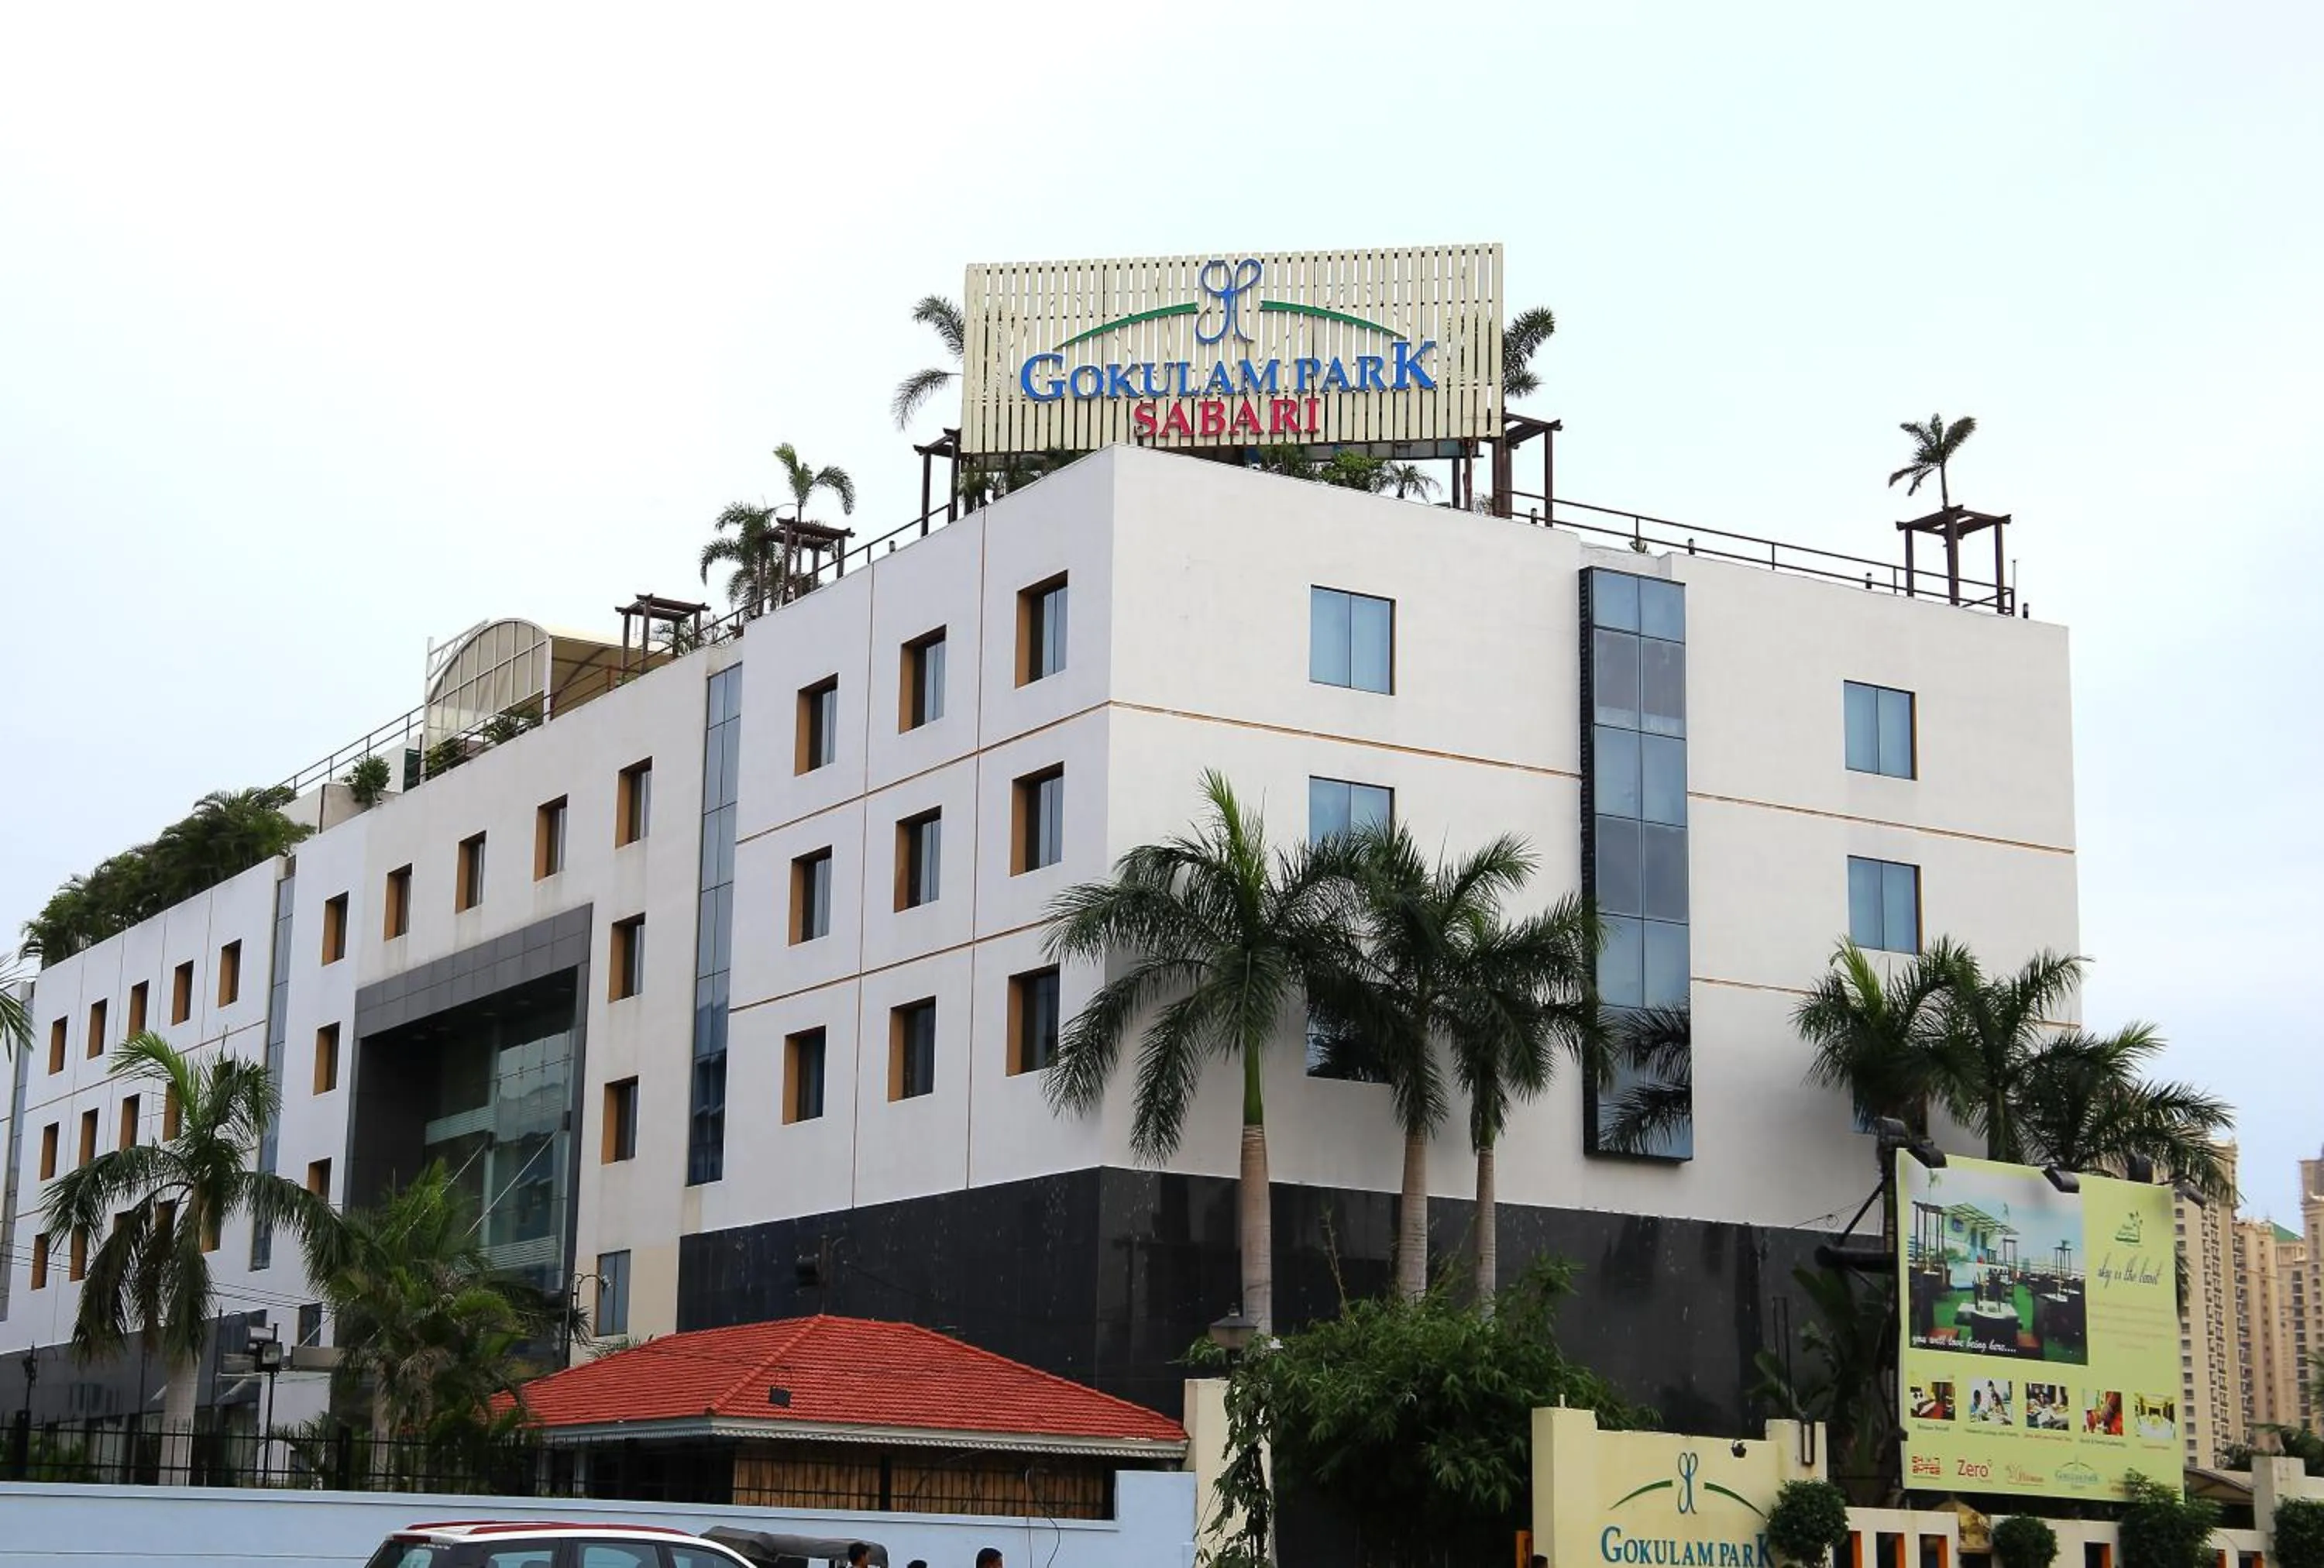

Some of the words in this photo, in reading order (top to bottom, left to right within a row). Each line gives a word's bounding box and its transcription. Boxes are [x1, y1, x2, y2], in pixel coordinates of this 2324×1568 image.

[1020, 352, 1281, 403] GOKULAM
[1294, 341, 1438, 394] PARK
[1134, 398, 1320, 438] SABARI
[1601, 1525, 1714, 1567] GOKULAM
[1719, 1533, 1776, 1568] PARK
